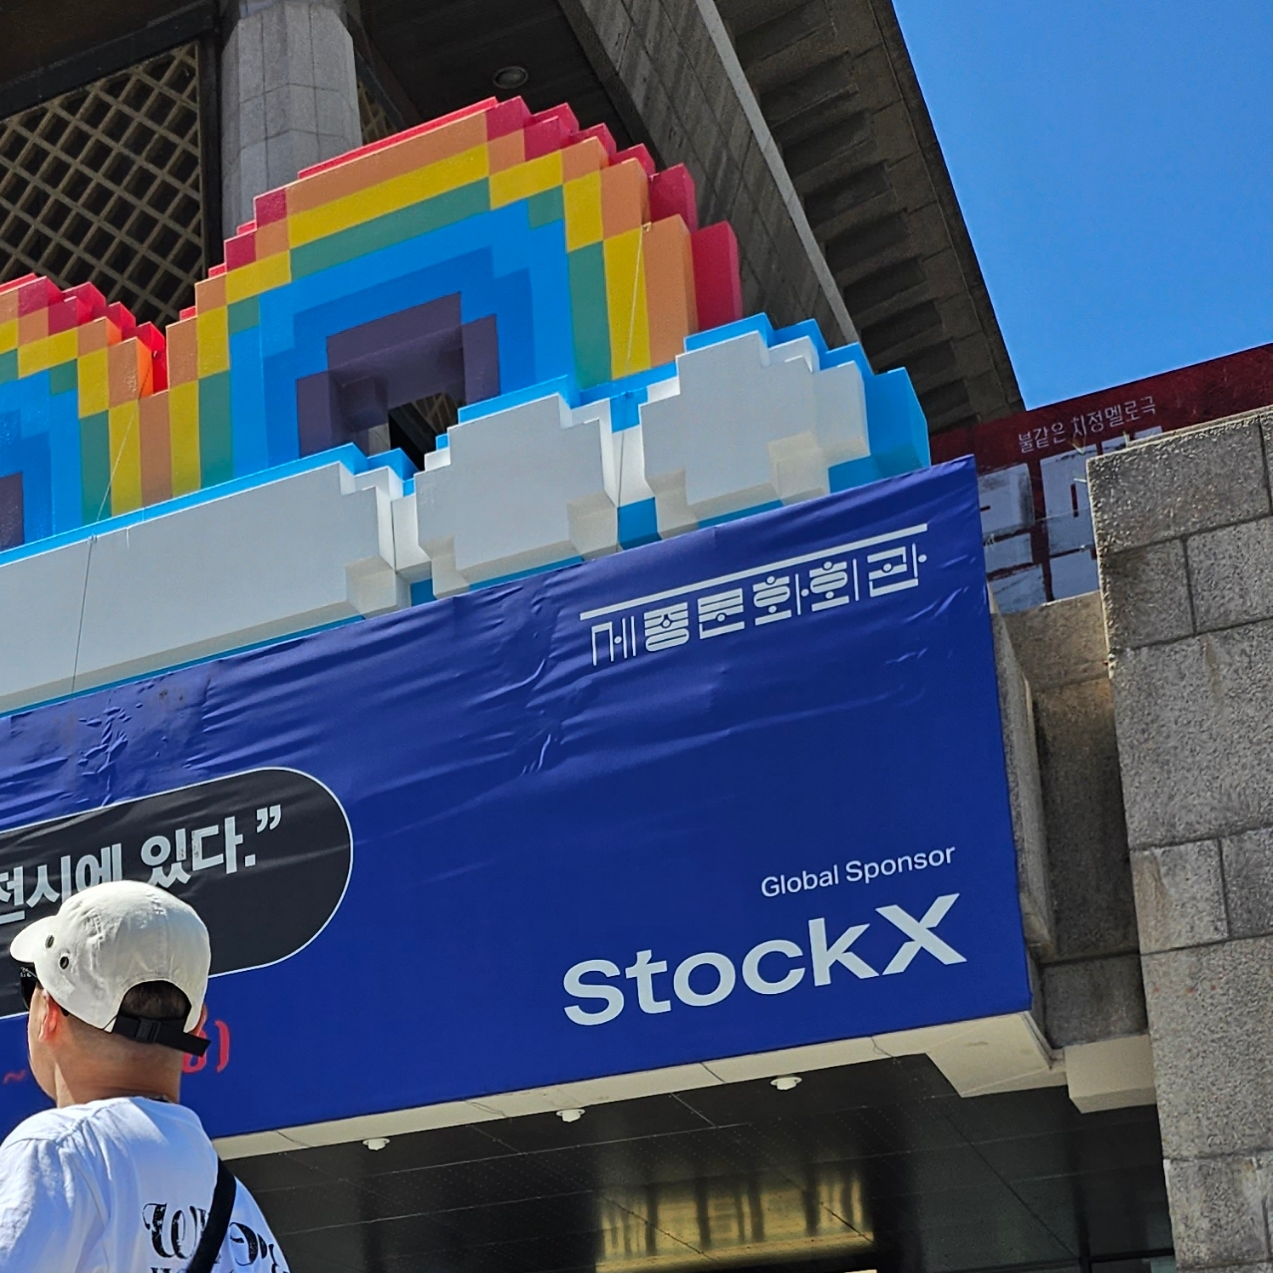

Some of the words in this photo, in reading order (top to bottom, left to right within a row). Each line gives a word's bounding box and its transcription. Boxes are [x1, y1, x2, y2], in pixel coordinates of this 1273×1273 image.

[1018, 421, 1067, 454] 불같은
[1070, 396, 1156, 437] 치정멜로극
[760, 864, 839, 897] Global
[845, 846, 956, 883] Sponsor
[562, 893, 968, 1026] StockX
